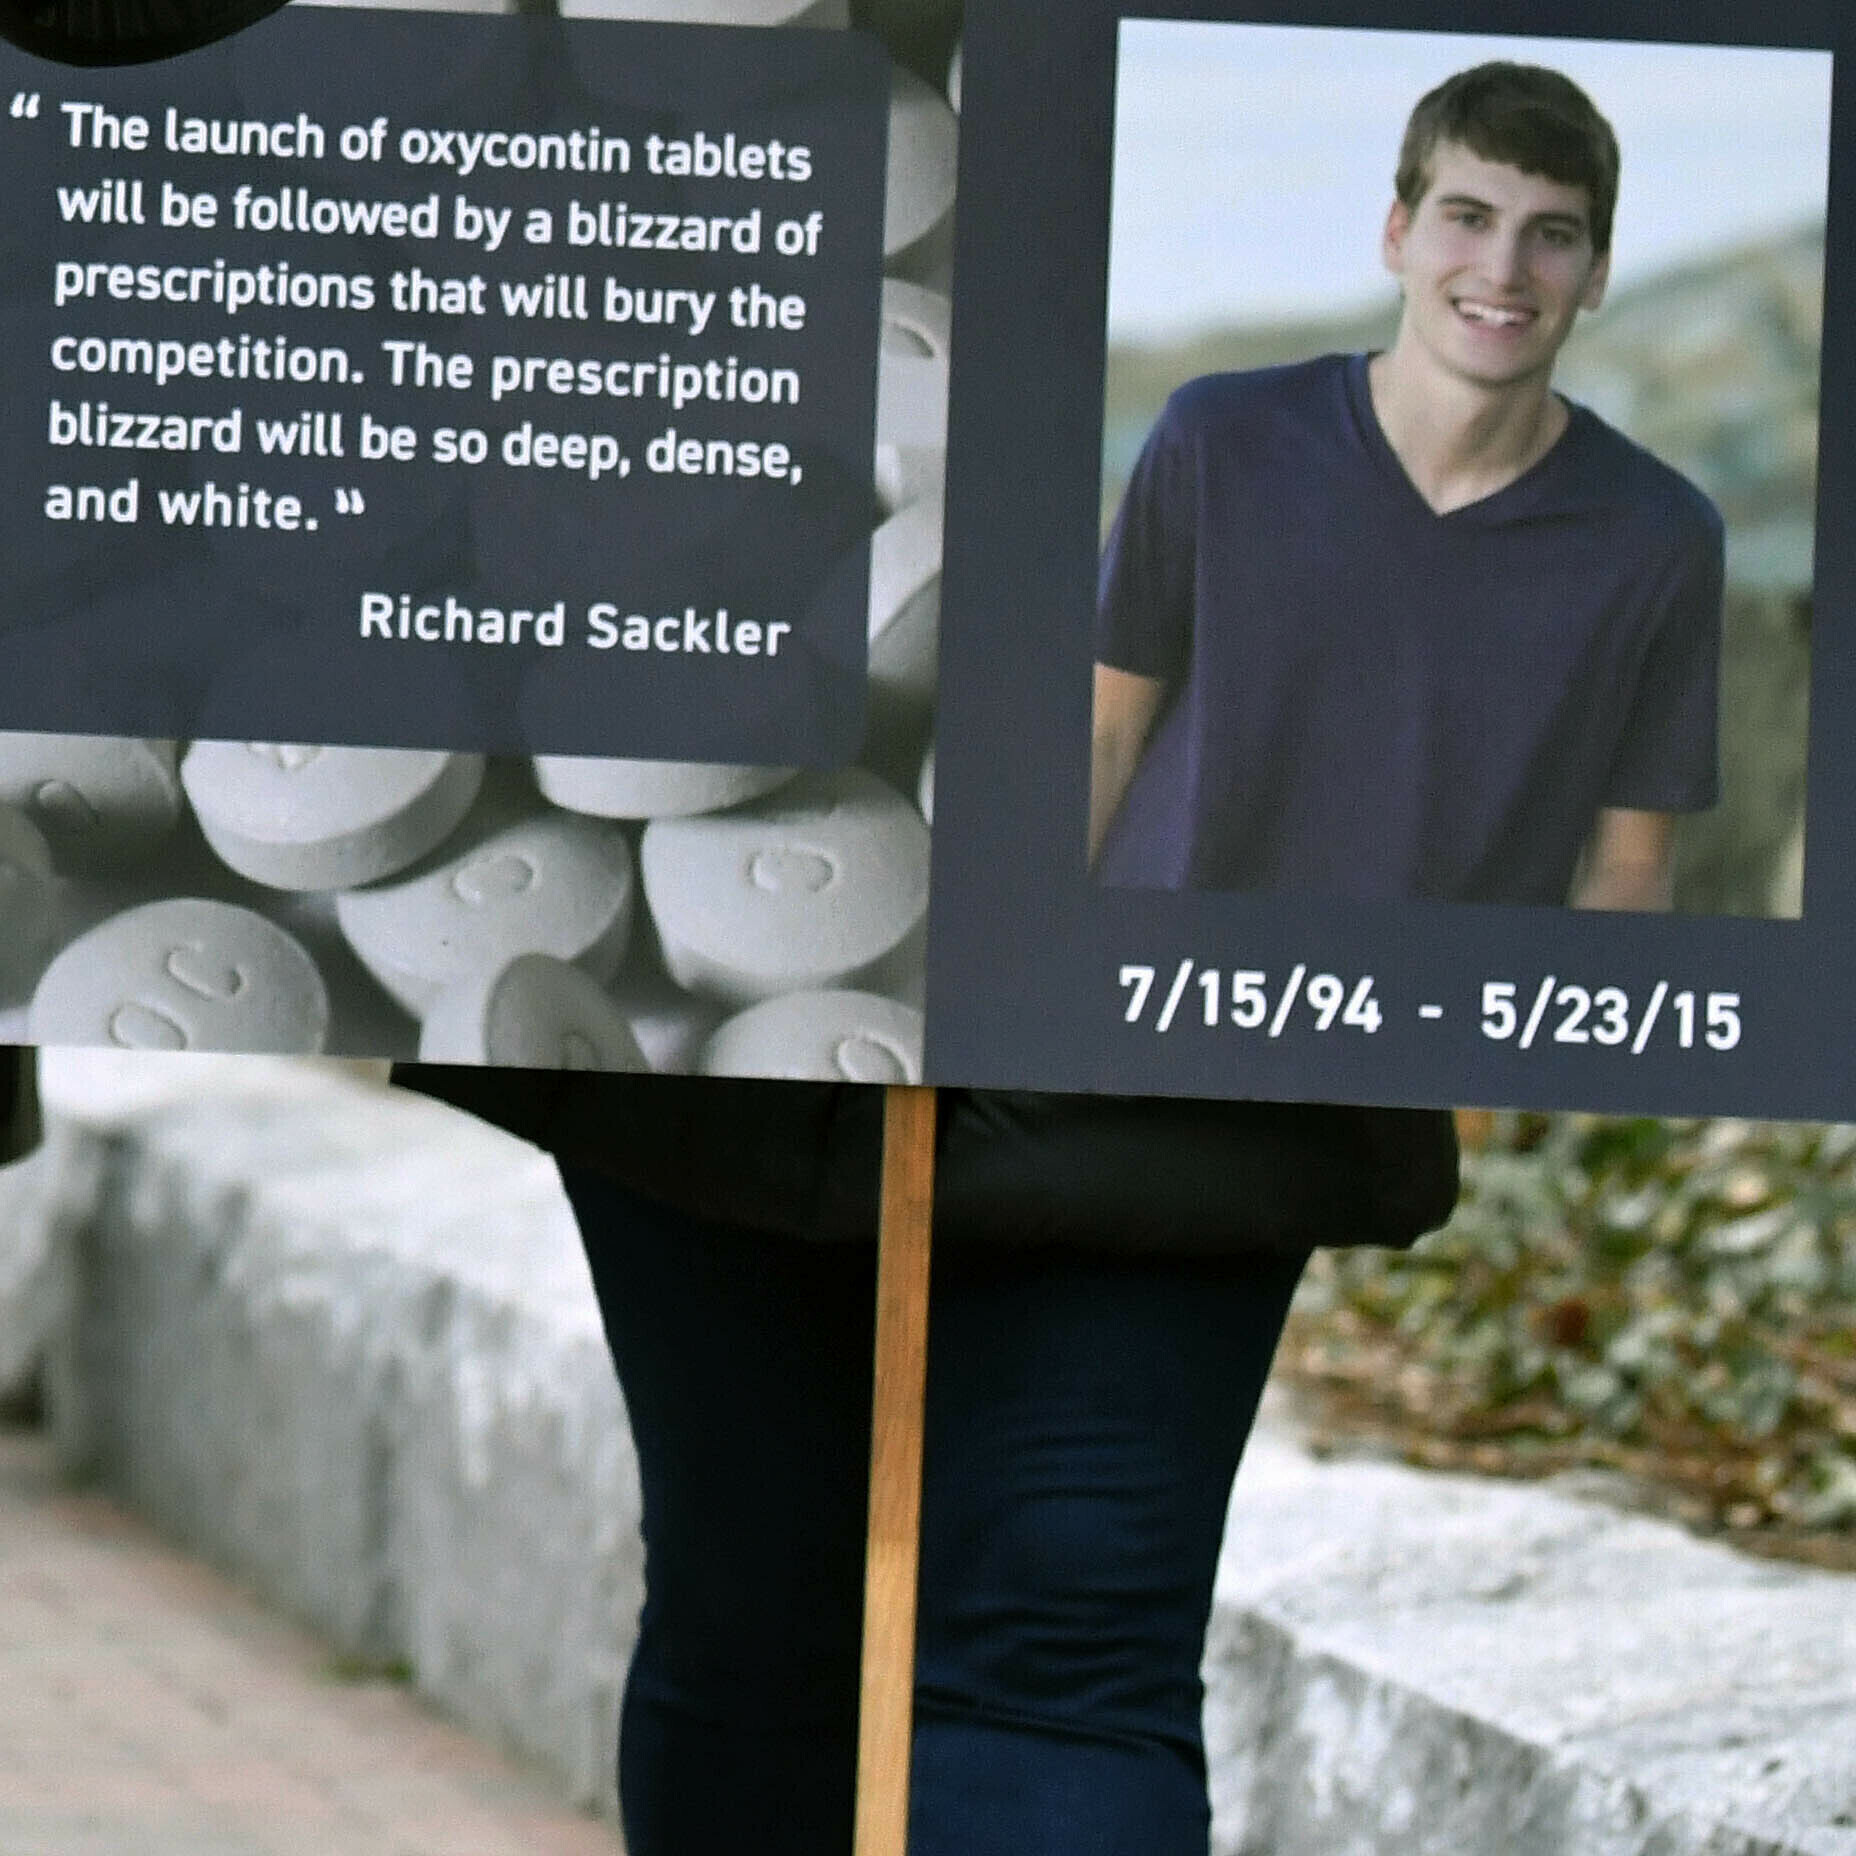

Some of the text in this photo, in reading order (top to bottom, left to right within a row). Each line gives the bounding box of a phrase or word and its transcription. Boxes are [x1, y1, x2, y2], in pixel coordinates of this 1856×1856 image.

[60, 102, 150, 151] The
[165, 107, 325, 159] launch
[340, 117, 388, 161] of
[400, 127, 631, 176] oxycontin
[645, 132, 812, 182] tablets
[57, 179, 823, 256] will be followed by a blizzard of
[55, 259, 806, 336] prescriptions that will bury the
[51, 334, 800, 410] competition. The prescription
[49, 400, 802, 485] blizzard will be so deep, dense,
[45, 479, 139, 523] and
[158, 482, 318, 531] white.
[360, 592, 791, 656] Richard Sackler
[1119, 959, 1383, 1038] 7/15/94
[1481, 976, 1741, 1055] 5/23/15
